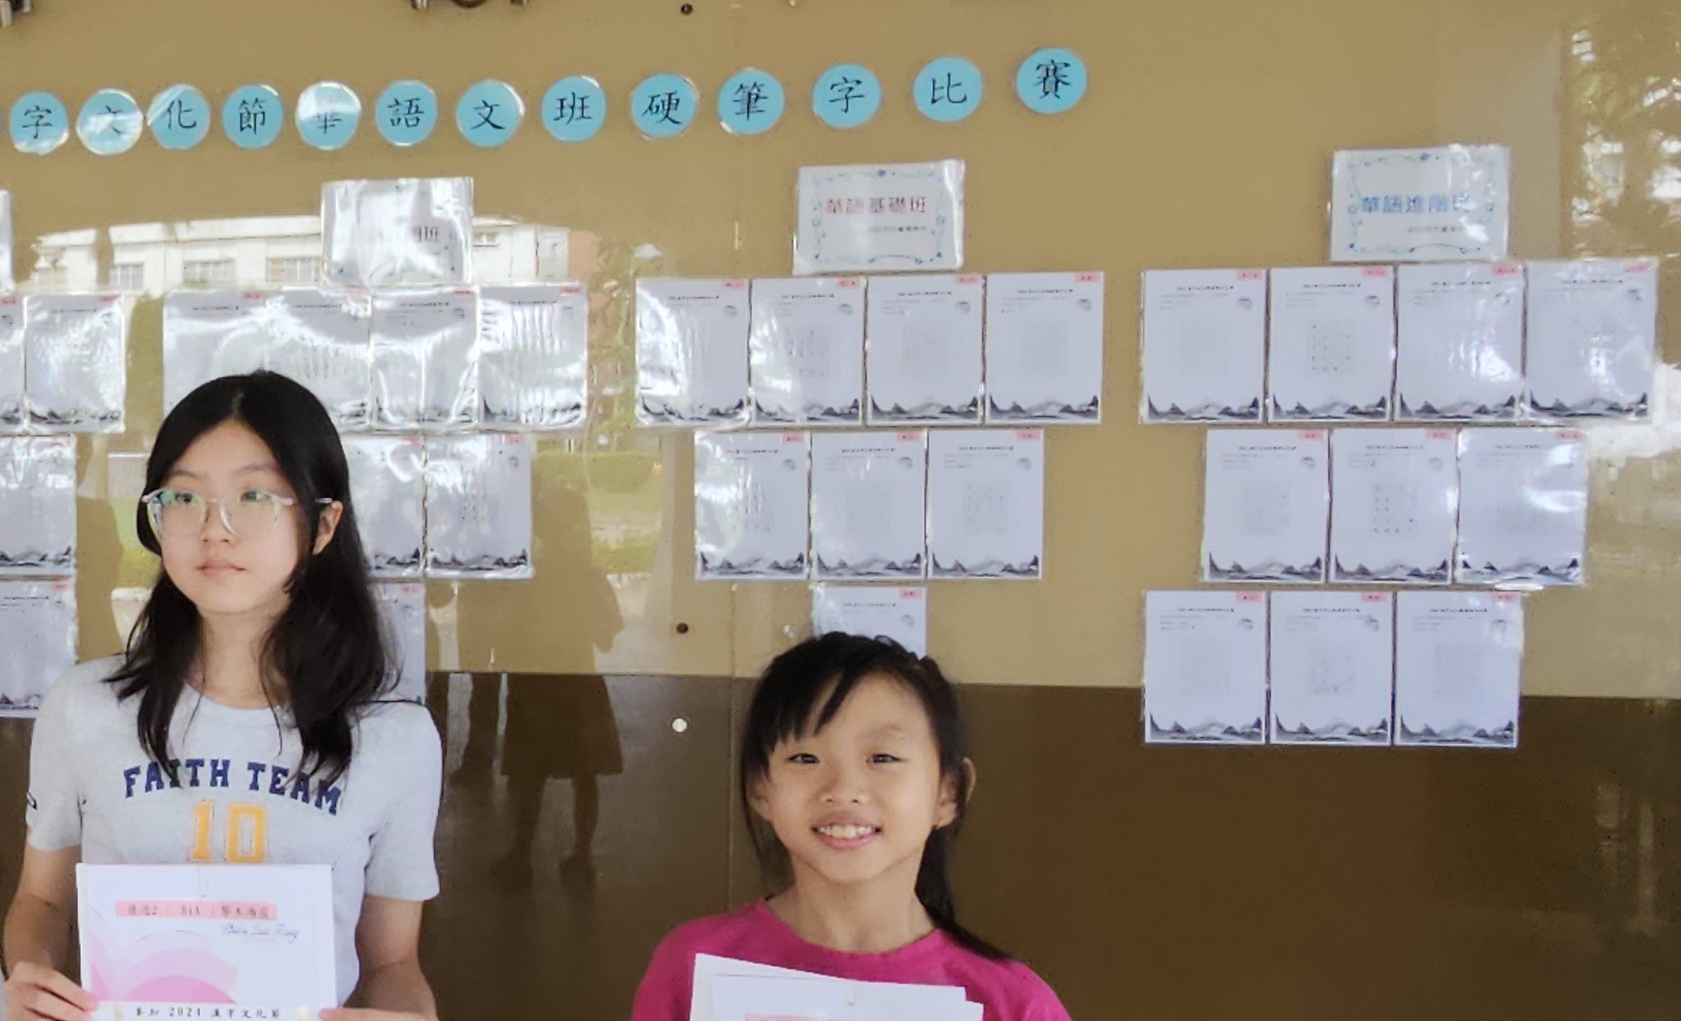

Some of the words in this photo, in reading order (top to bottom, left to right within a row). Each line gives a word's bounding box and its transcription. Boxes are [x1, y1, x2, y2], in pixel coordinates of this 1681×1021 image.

[123, 759, 231, 798] FAITH
[247, 762, 342, 815] TEAM
[187, 799, 268, 863] 10
